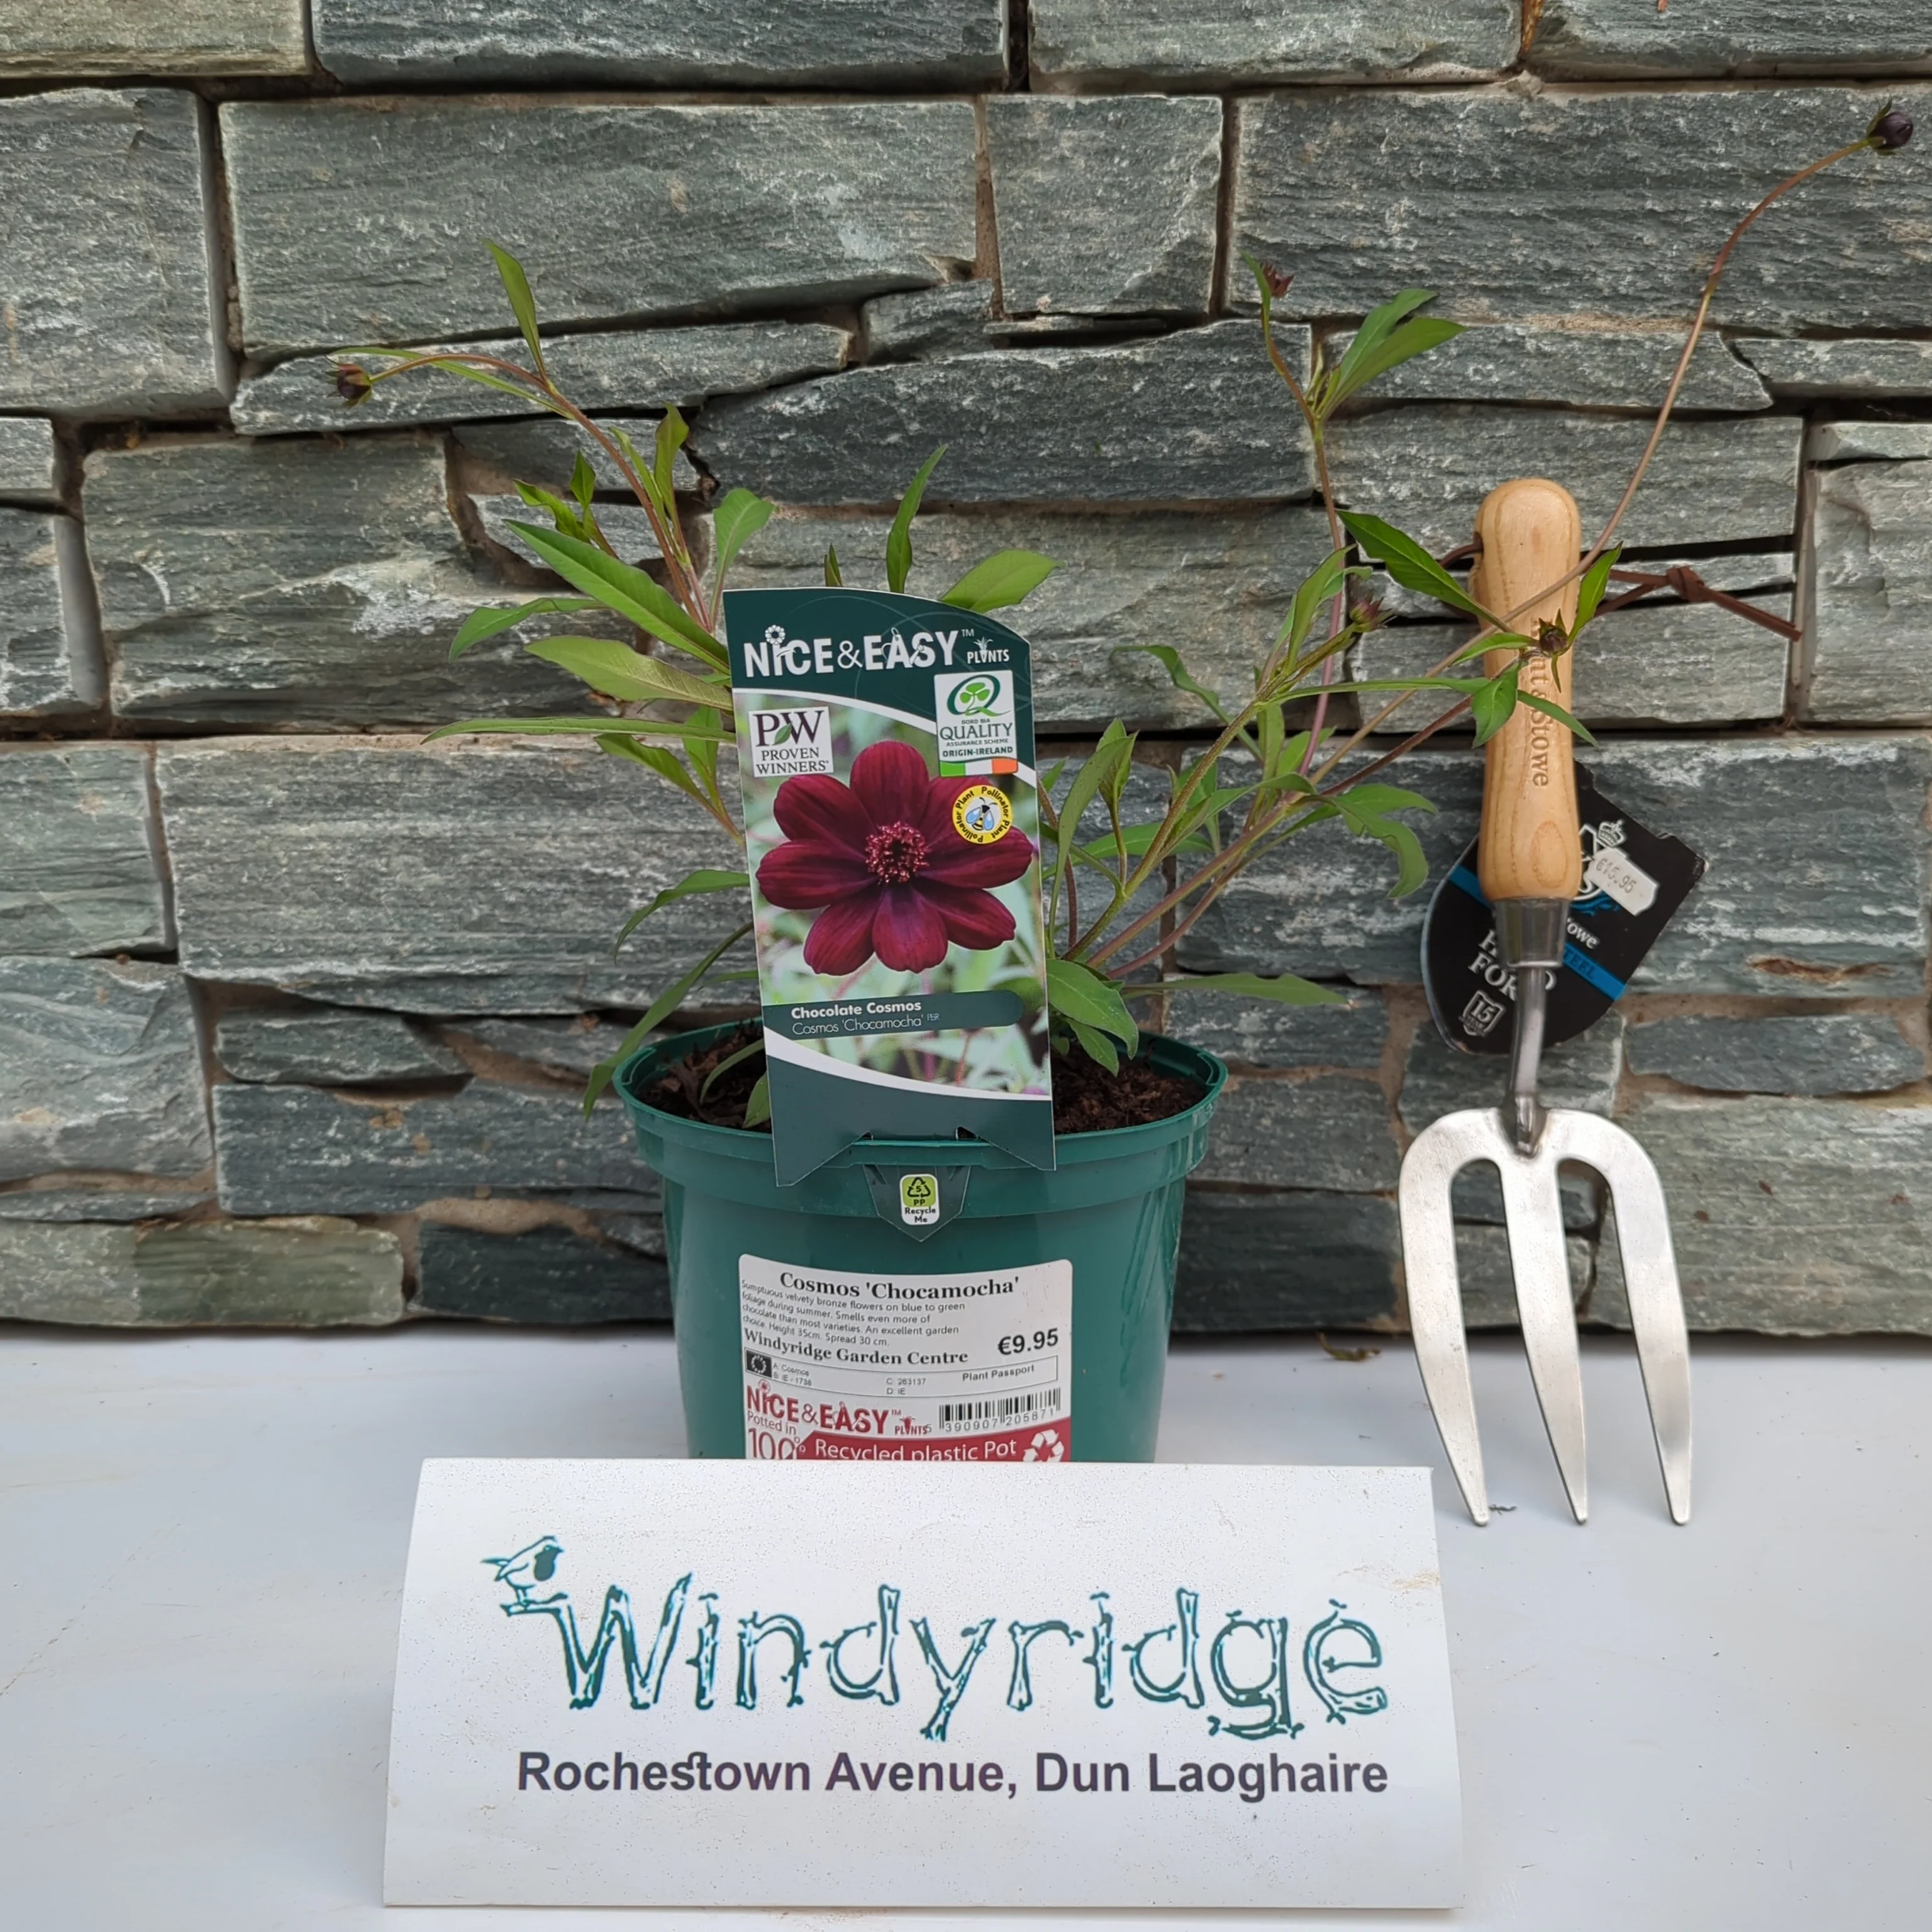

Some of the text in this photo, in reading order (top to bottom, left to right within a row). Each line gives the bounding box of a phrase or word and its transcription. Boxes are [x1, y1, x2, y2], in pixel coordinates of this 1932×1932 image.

[967, 648, 1010, 664] PLANTS
[940, 723, 1013, 741] QUALITY
[761, 747, 819, 761] PROVEN
[942, 747, 1013, 757] ORIGIN-IRELAND
[1566, 917, 1599, 950] owe
[791, 1002, 921, 1019] Chocolate Cosmos
[792, 1022, 839, 1035] Cosmos
[842, 1014, 923, 1031] 'Chocamocha'
[904, 1206, 936, 1216] Recycle
[742, 1280, 783, 1298] Sumptuous
[785, 1292, 814, 1306] velvety
[817, 1297, 847, 1308] bronze
[850, 1300, 883, 1311] flowers
[902, 1302, 922, 1311] blue
[925, 1303, 935, 1311] to
[938, 1302, 965, 1313] green
[780, 1272, 1019, 1299] Cosmos 'Chocamocha'
[742, 1291, 766, 1306] foliage
[767, 1298, 794, 1313] during
[796, 1306, 833, 1318] summer.
[836, 1311, 865, 1321] Smells
[867, 1315, 890, 1323] even
[920, 1314, 931, 1323] of
[743, 1304, 959, 1336] chocolate than most varieties. An excellent garden
[745, 1328, 969, 1365] Windyridge Garden Centre
[769, 1323, 796, 1336] Height
[826, 1333, 857, 1345] Spread
[860, 1336, 871, 1345] 30
[874, 1338, 890, 1347] cm.
[997, 1327, 1059, 1356] €9.95
[781, 1364, 810, 1376] Cosmos
[962, 1364, 1035, 1381] Plant Passport
[747, 1411, 797, 1436] Potted in
[945, 1419, 998, 1433] 390907
[1006, 1407, 1054, 1426] 205871
[816, 1438, 1017, 1461] Recycled plastic Pot
[500, 1571, 1388, 1741] Windyridge
[518, 1751, 1389, 1804] Rochestown Avenue, Dun Laoghaire
